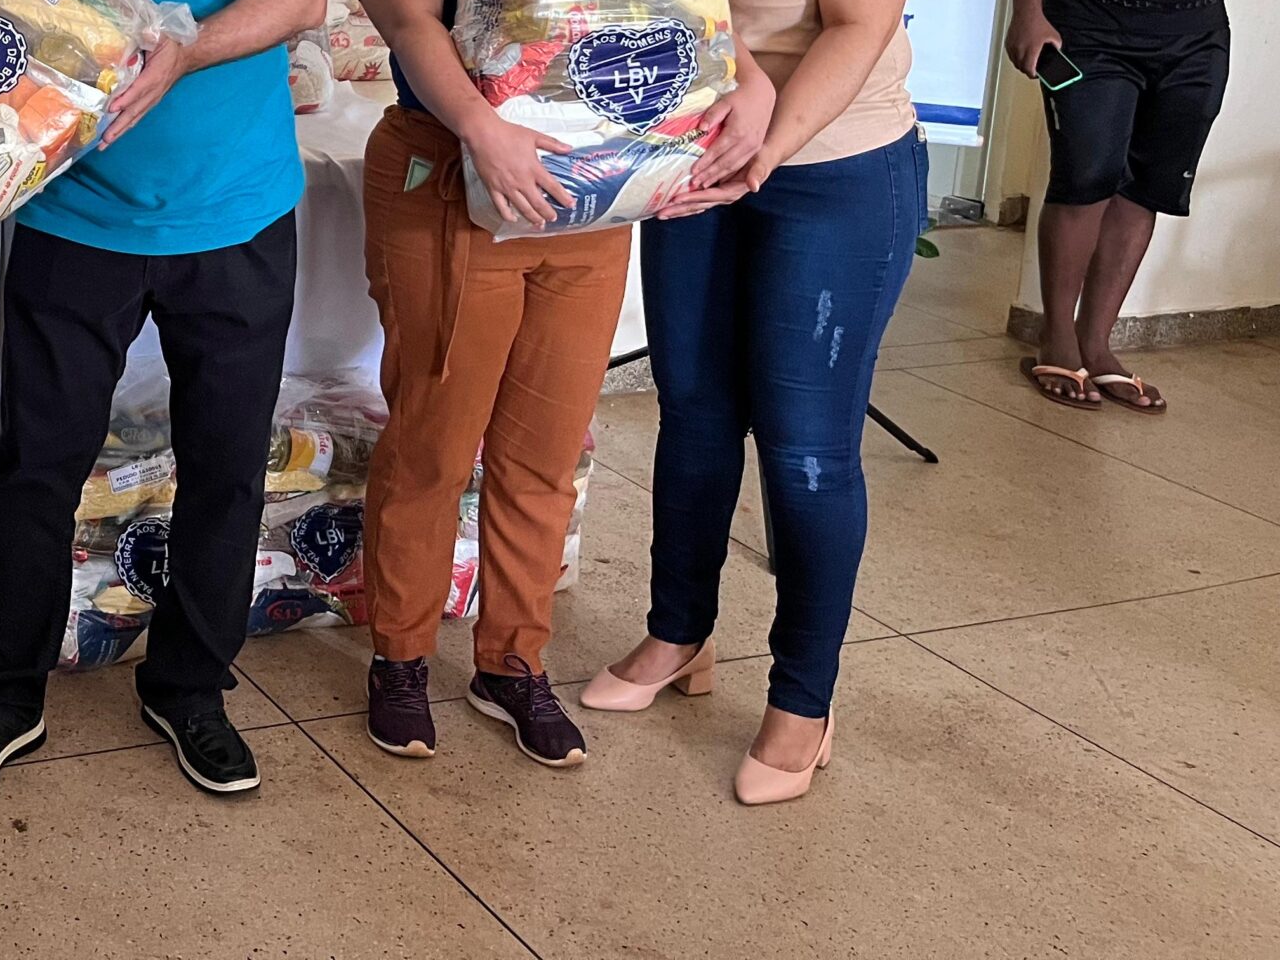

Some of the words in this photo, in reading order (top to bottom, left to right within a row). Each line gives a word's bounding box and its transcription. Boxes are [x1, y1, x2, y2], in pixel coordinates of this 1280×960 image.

[592, 35, 617, 48] AOS
[619, 29, 672, 49] HOMENS
[5, 48, 17, 65] DE
[613, 65, 659, 88] LBV
[136, 525, 156, 537] AOS
[316, 528, 345, 545] LBV
